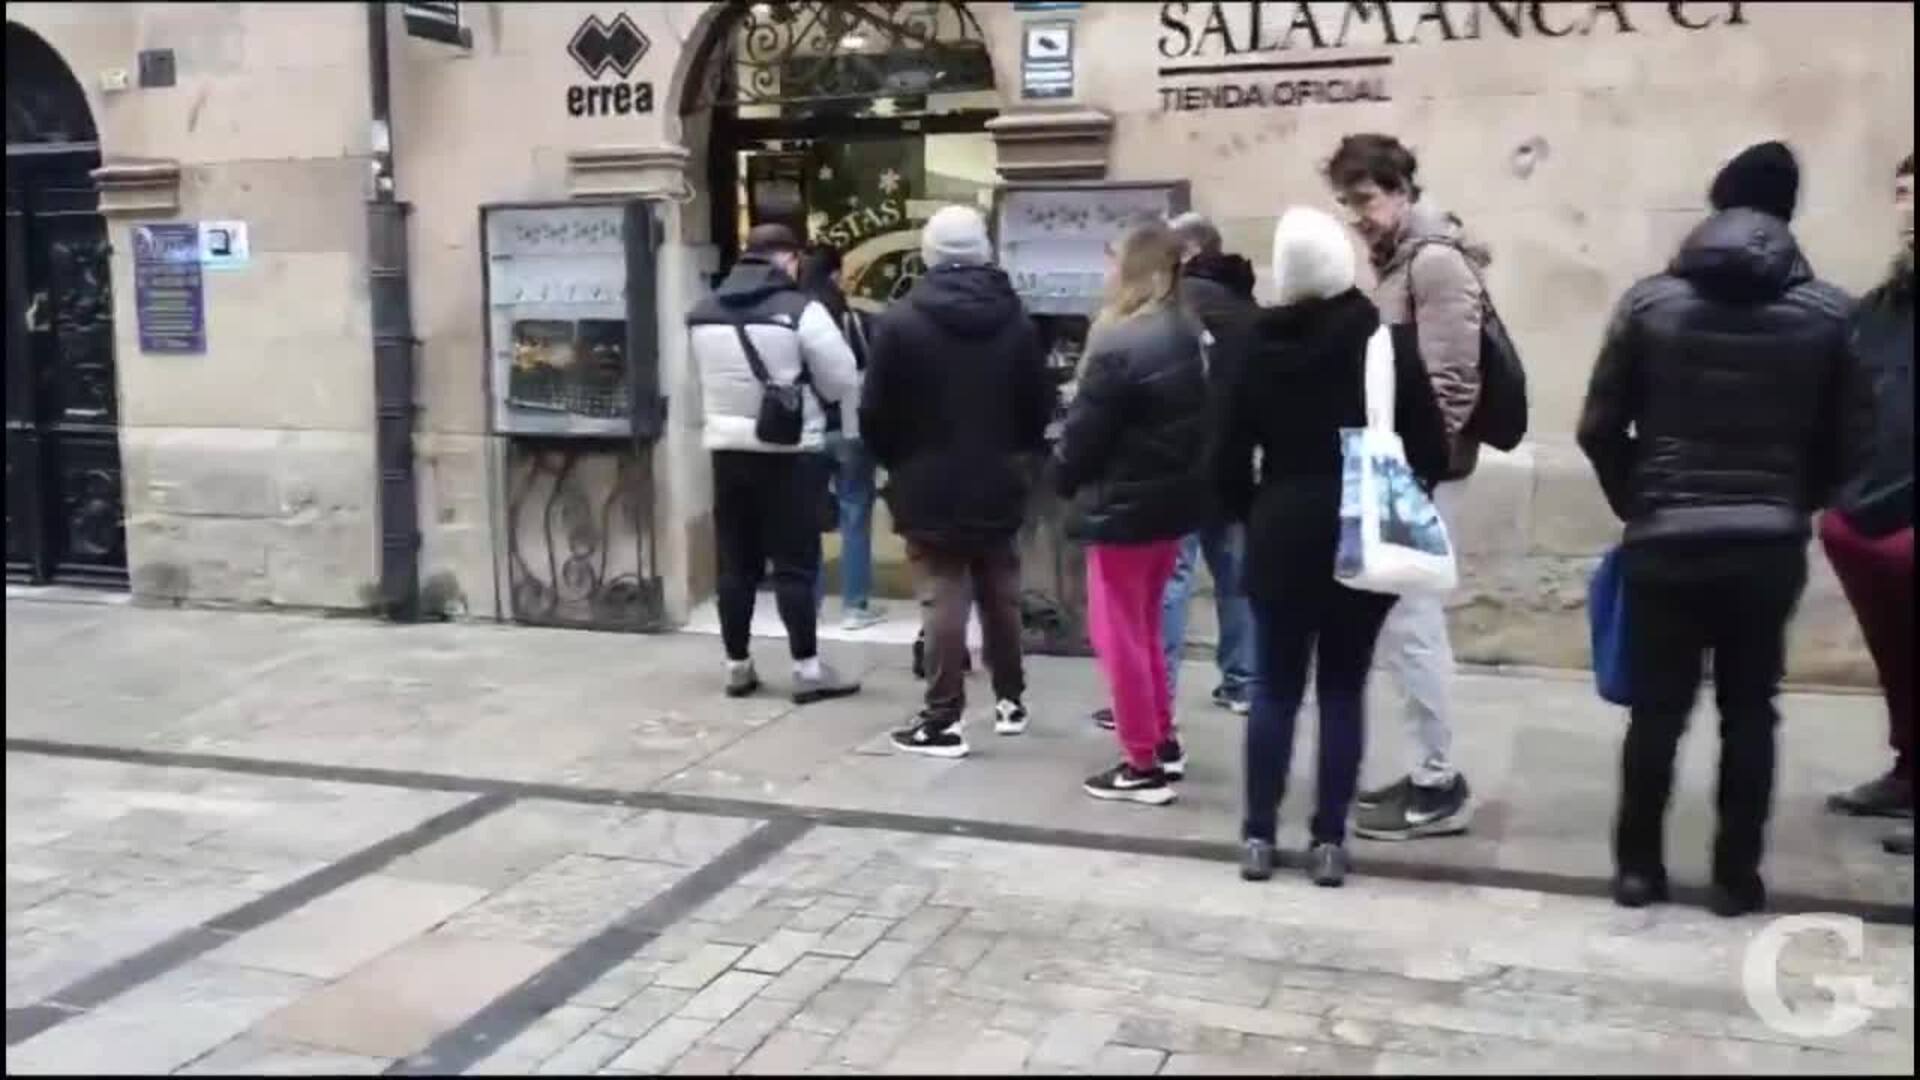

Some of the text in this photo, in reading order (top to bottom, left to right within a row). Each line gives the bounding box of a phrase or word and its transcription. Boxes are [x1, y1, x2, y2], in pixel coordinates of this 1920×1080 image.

[1158, 2, 1638, 57] SALAMANCA
[1159, 78, 1392, 111] TIENDA OFICIAL
